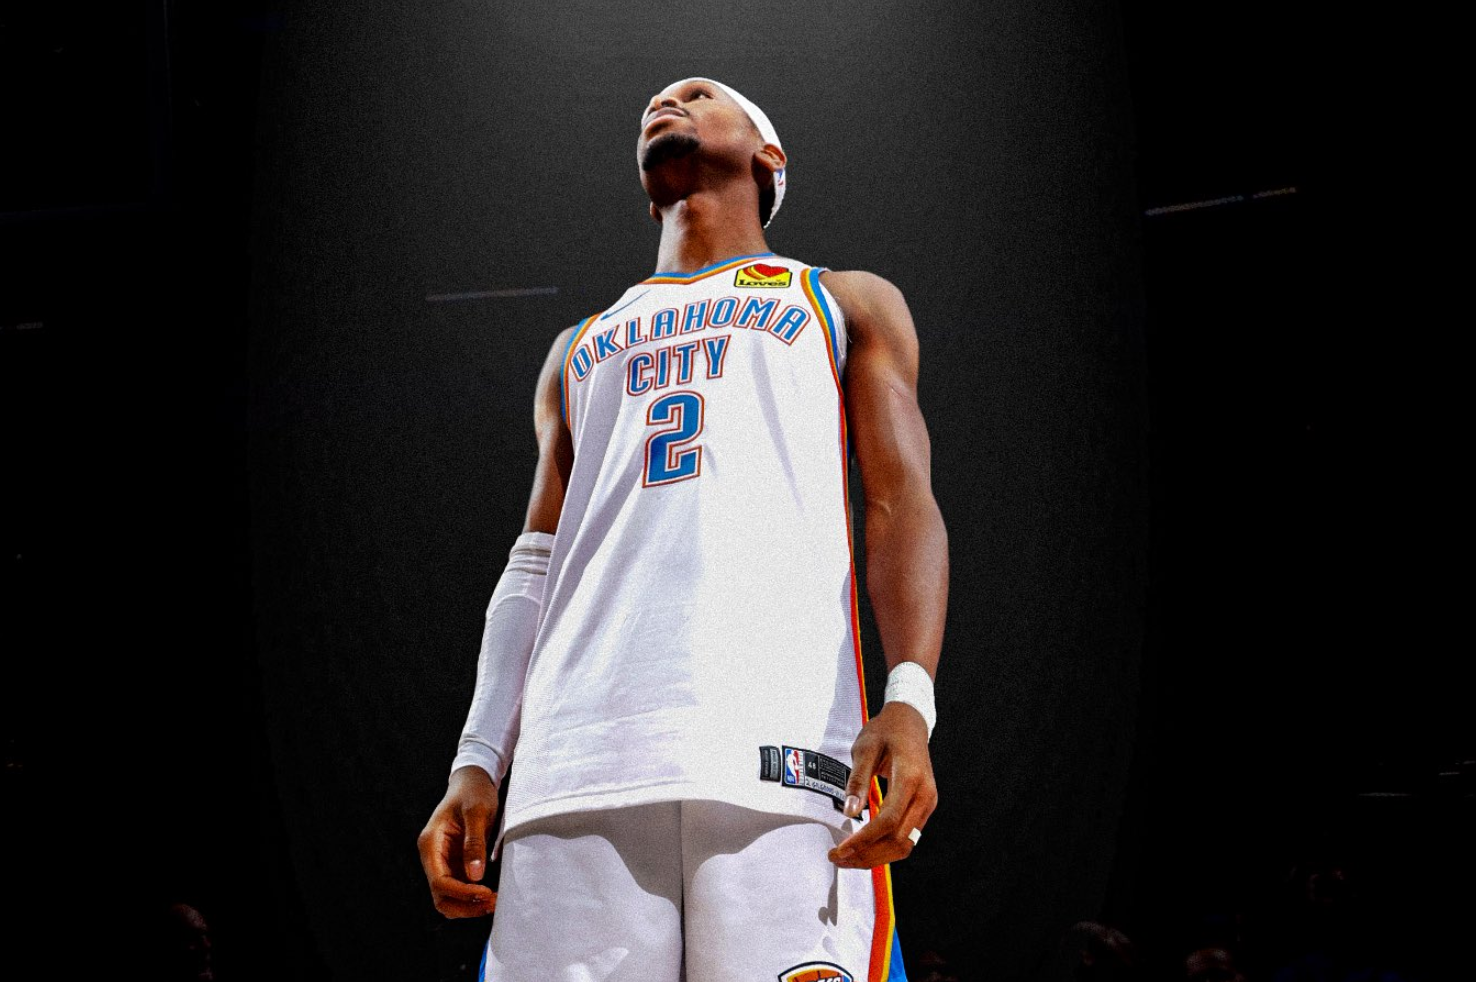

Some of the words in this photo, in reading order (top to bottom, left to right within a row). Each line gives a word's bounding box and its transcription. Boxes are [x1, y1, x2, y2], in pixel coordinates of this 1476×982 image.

[570, 296, 811, 382] OKLAHOMA
[626, 334, 732, 397] CITY
[642, 390, 705, 489] 2
